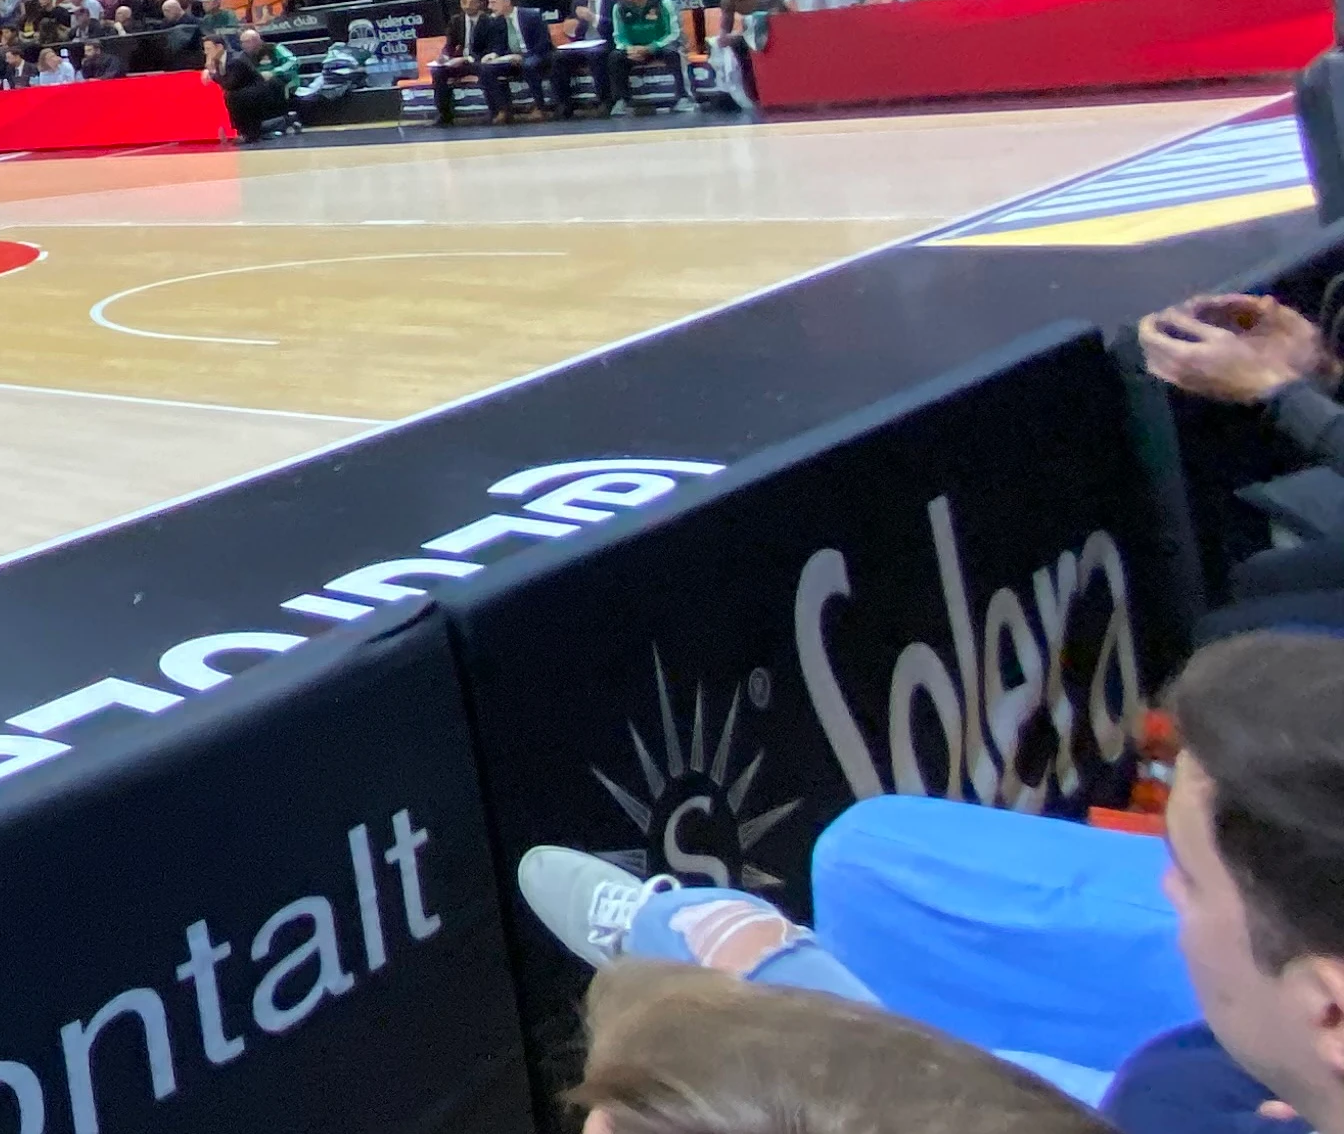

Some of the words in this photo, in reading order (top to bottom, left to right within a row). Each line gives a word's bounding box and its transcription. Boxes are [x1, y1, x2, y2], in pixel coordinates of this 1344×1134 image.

[293, 14, 318, 27] club
[375, 13, 424, 30] valencia
[378, 26, 418, 44] basket
[380, 40, 409, 55] club
[795, 496, 1144, 814] Solera
